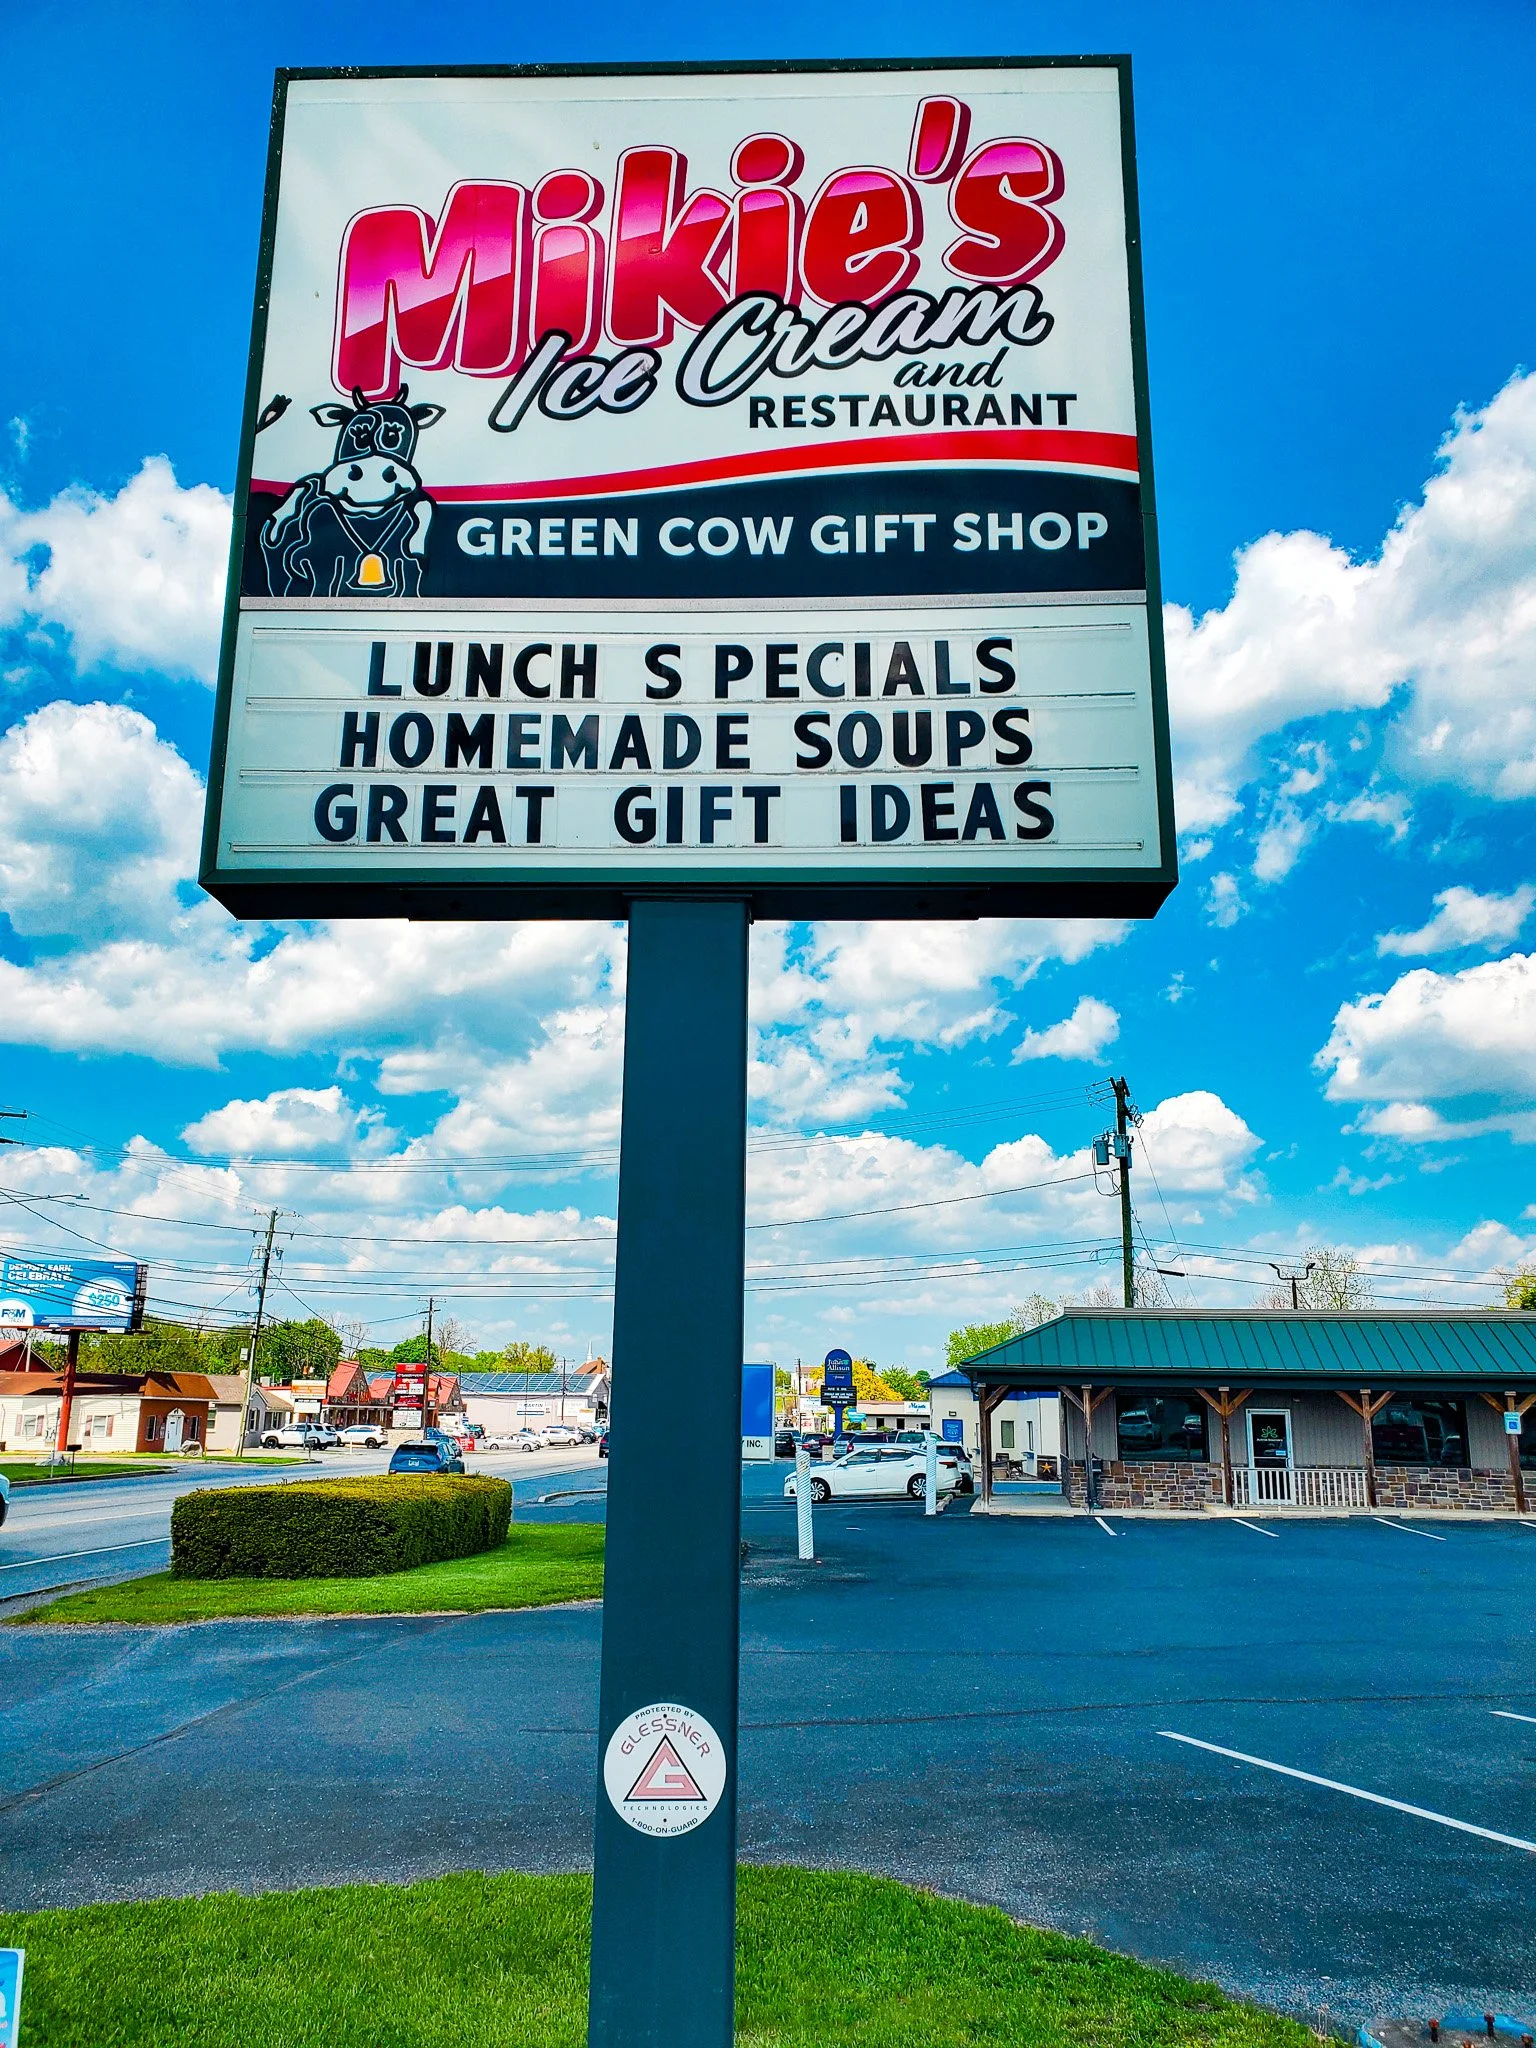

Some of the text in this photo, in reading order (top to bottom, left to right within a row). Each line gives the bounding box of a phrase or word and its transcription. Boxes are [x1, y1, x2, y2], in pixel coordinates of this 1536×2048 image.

[335, 95, 1065, 398] Mikie's
[489, 286, 1054, 433] Ice Cream
[894, 347, 1003, 389] and
[748, 393, 1077, 429] RESTAURANT
[456, 511, 1109, 557] GREEN COW GIFT SHOP
[367, 641, 598, 699] LUNCH
[340, 707, 1033, 769] HOMEMADE SOUPS
[313, 781, 1055, 844] GREAT GIFT IDEAS
[746, 1440, 763, 1448] INC.
[634, 1706, 695, 1721] PROTECTED BY
[620, 1718, 711, 1758] GLESSNER
[631, 1817, 699, 1834] 1-800-ON-GUARD
